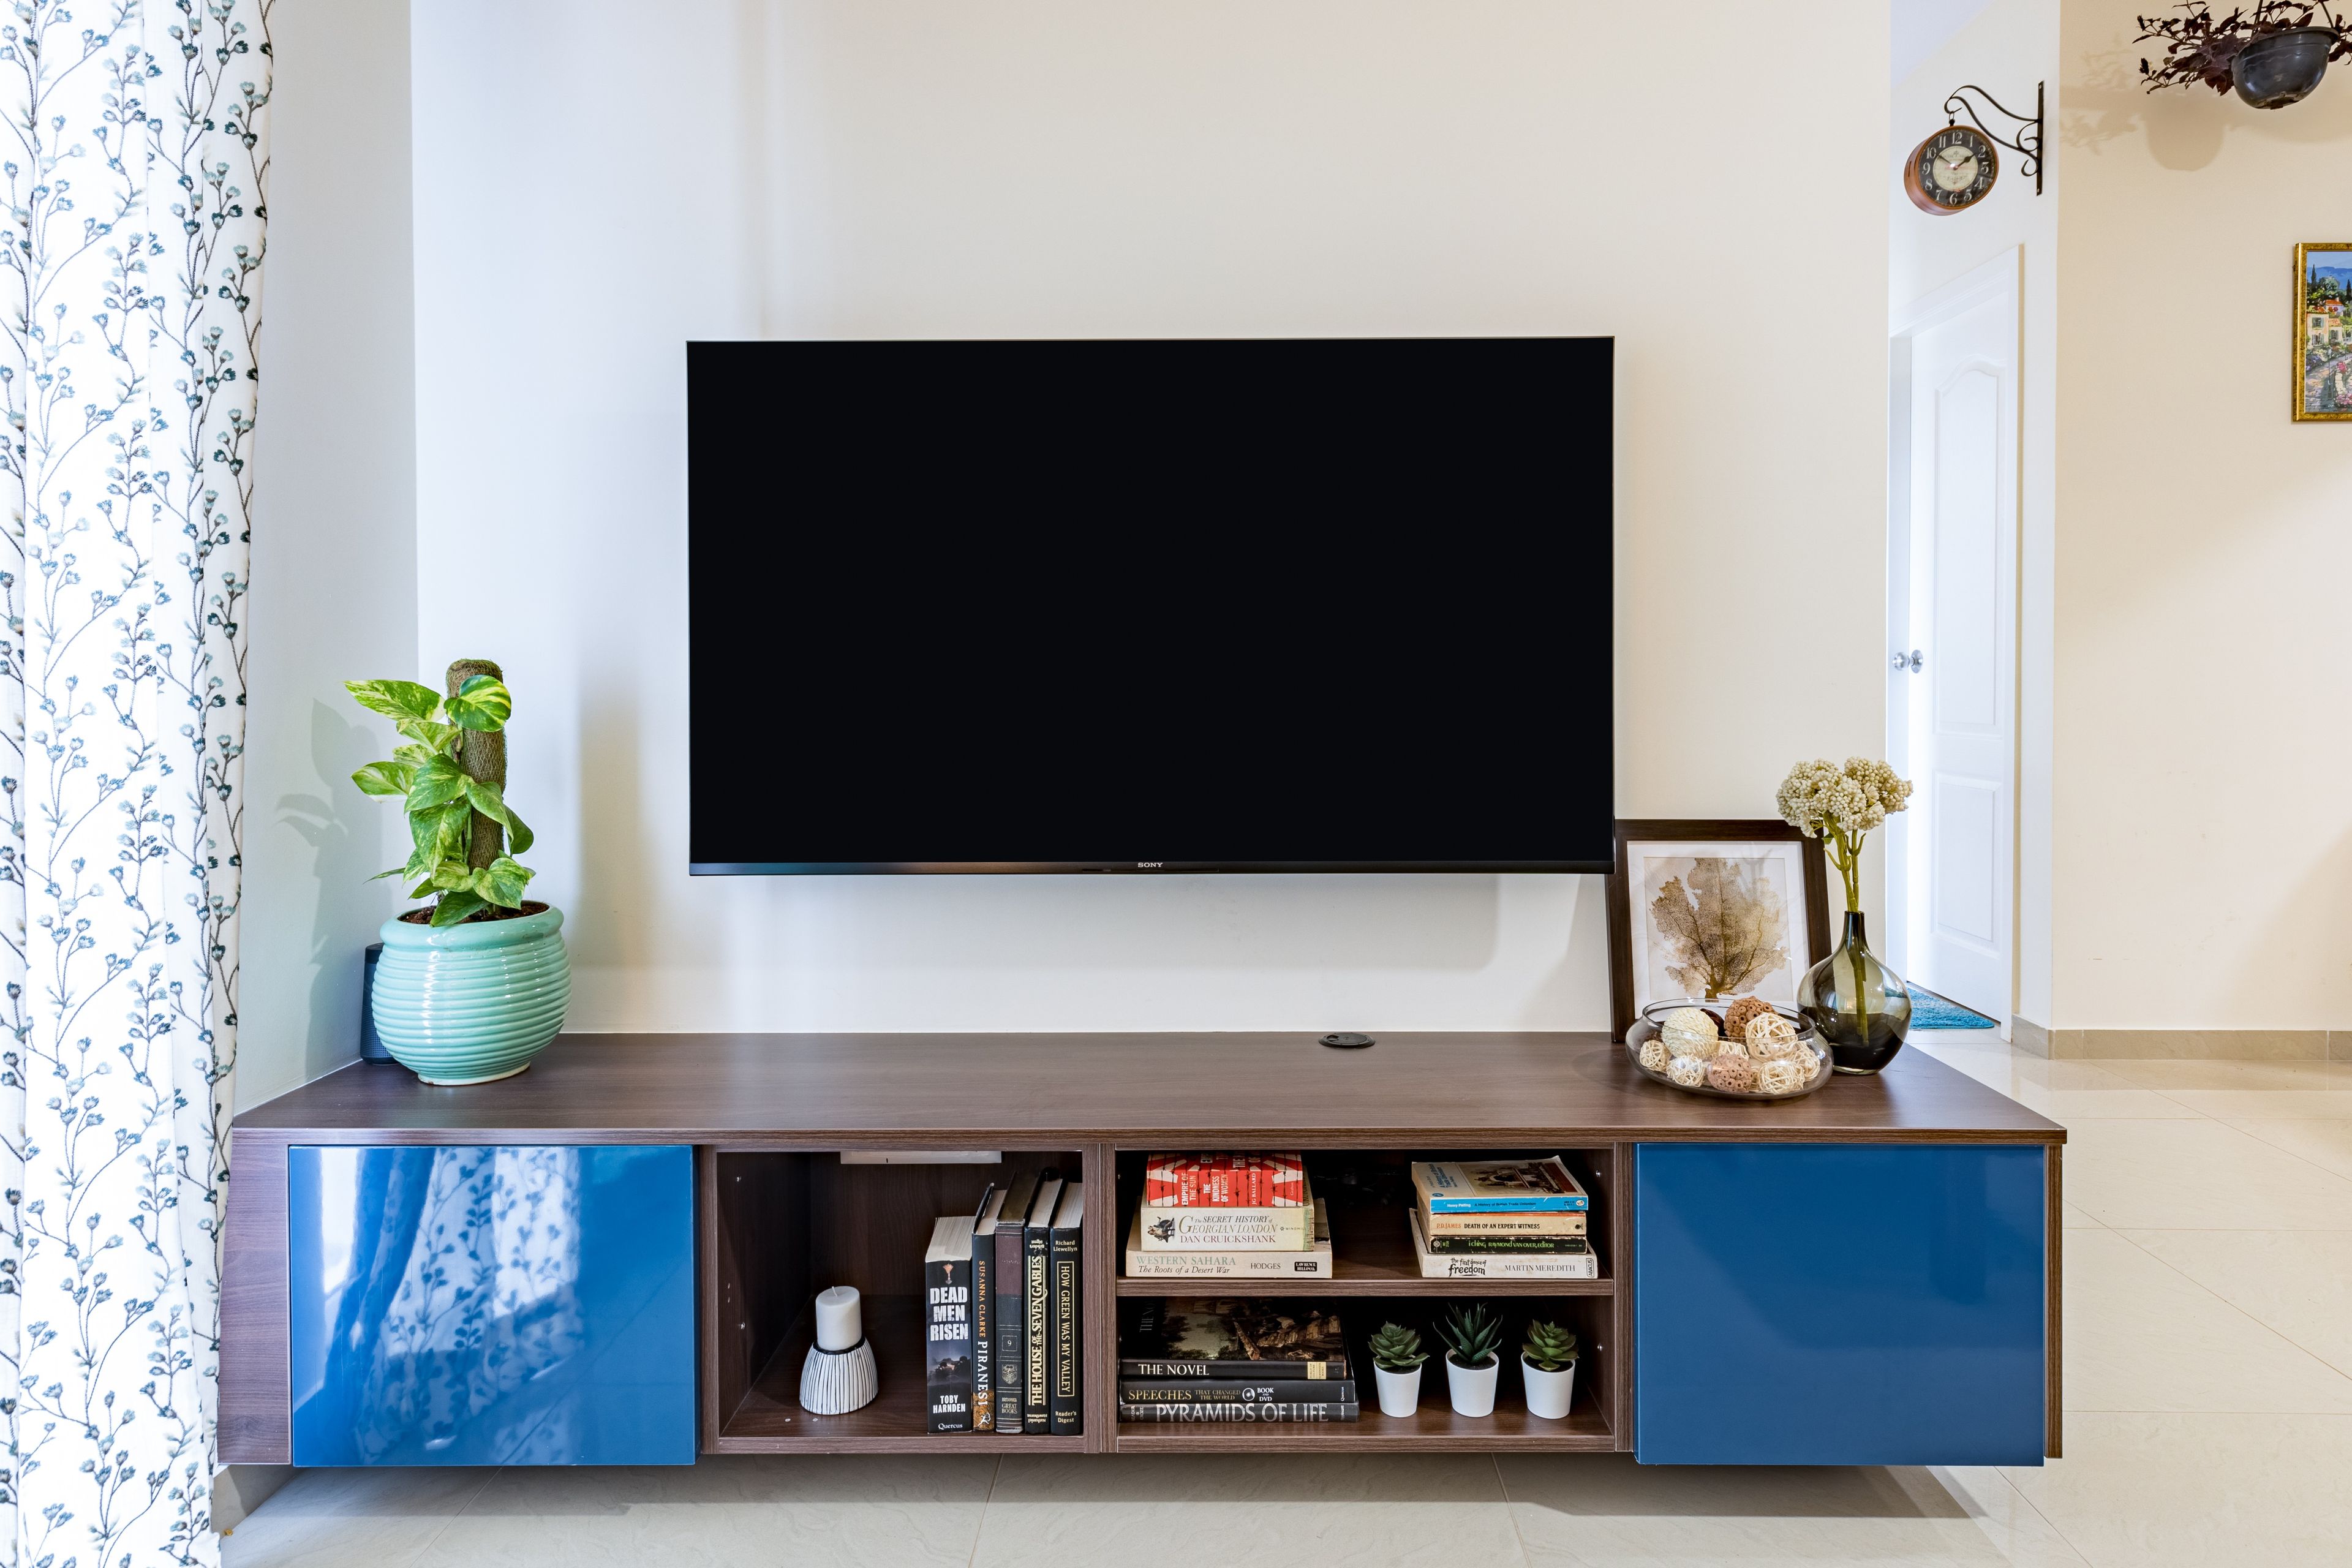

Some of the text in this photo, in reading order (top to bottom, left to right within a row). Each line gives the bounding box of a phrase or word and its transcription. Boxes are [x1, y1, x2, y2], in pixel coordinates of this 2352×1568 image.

[1939, 135, 1947, 148] 11
[1952, 132, 1962, 145] 12
[1969, 135, 1973, 147] 1
[1926, 147, 1937, 159] 10
[1978, 145, 1986, 158] 2
[1922, 162, 1931, 175] 9
[1980, 162, 1989, 174] 3
[1924, 179, 1933, 190] 8
[1974, 177, 1985, 189] 4
[1936, 189, 1942, 201] 7
[1950, 193, 1958, 205] 6
[1964, 189, 1972, 202] 5
[1182, 1172, 1189, 1181] OF
[1221, 1194, 1229, 1202] OF
[1179, 1216, 1278, 1234] GEORGIAN LONDON
[1136, 1256, 1237, 1265] WESTERN SAHARA
[1031, 1256, 1042, 1296] GABLES
[1175, 1265, 1185, 1275] of
[1449, 1264, 1486, 1277] freedom
[930, 1287, 968, 1304] DEAD
[933, 1305, 965, 1322] MEN
[1031, 1290, 1047, 1332] SEVEN
[930, 1324, 968, 1341] RISEN
[1061, 1266, 1071, 1392] HOW GREEN WAS MY VALLEY
[1031, 1346, 1042, 1382] HOUSE
[1137, 1363, 1210, 1375] THE NOVEL
[978, 1341, 988, 1405] PIRANESI
[940, 1395, 959, 1404] TOBY
[1031, 1384, 1042, 1406] THE
[1128, 1390, 1192, 1400] SPEECHES
[933, 1403, 966, 1414] HARNDEN
[1156, 1403, 1256, 1422] PYRAMIDS
[1262, 1403, 1287, 1422] OF
[1292, 1403, 1329, 1422] LIFE
